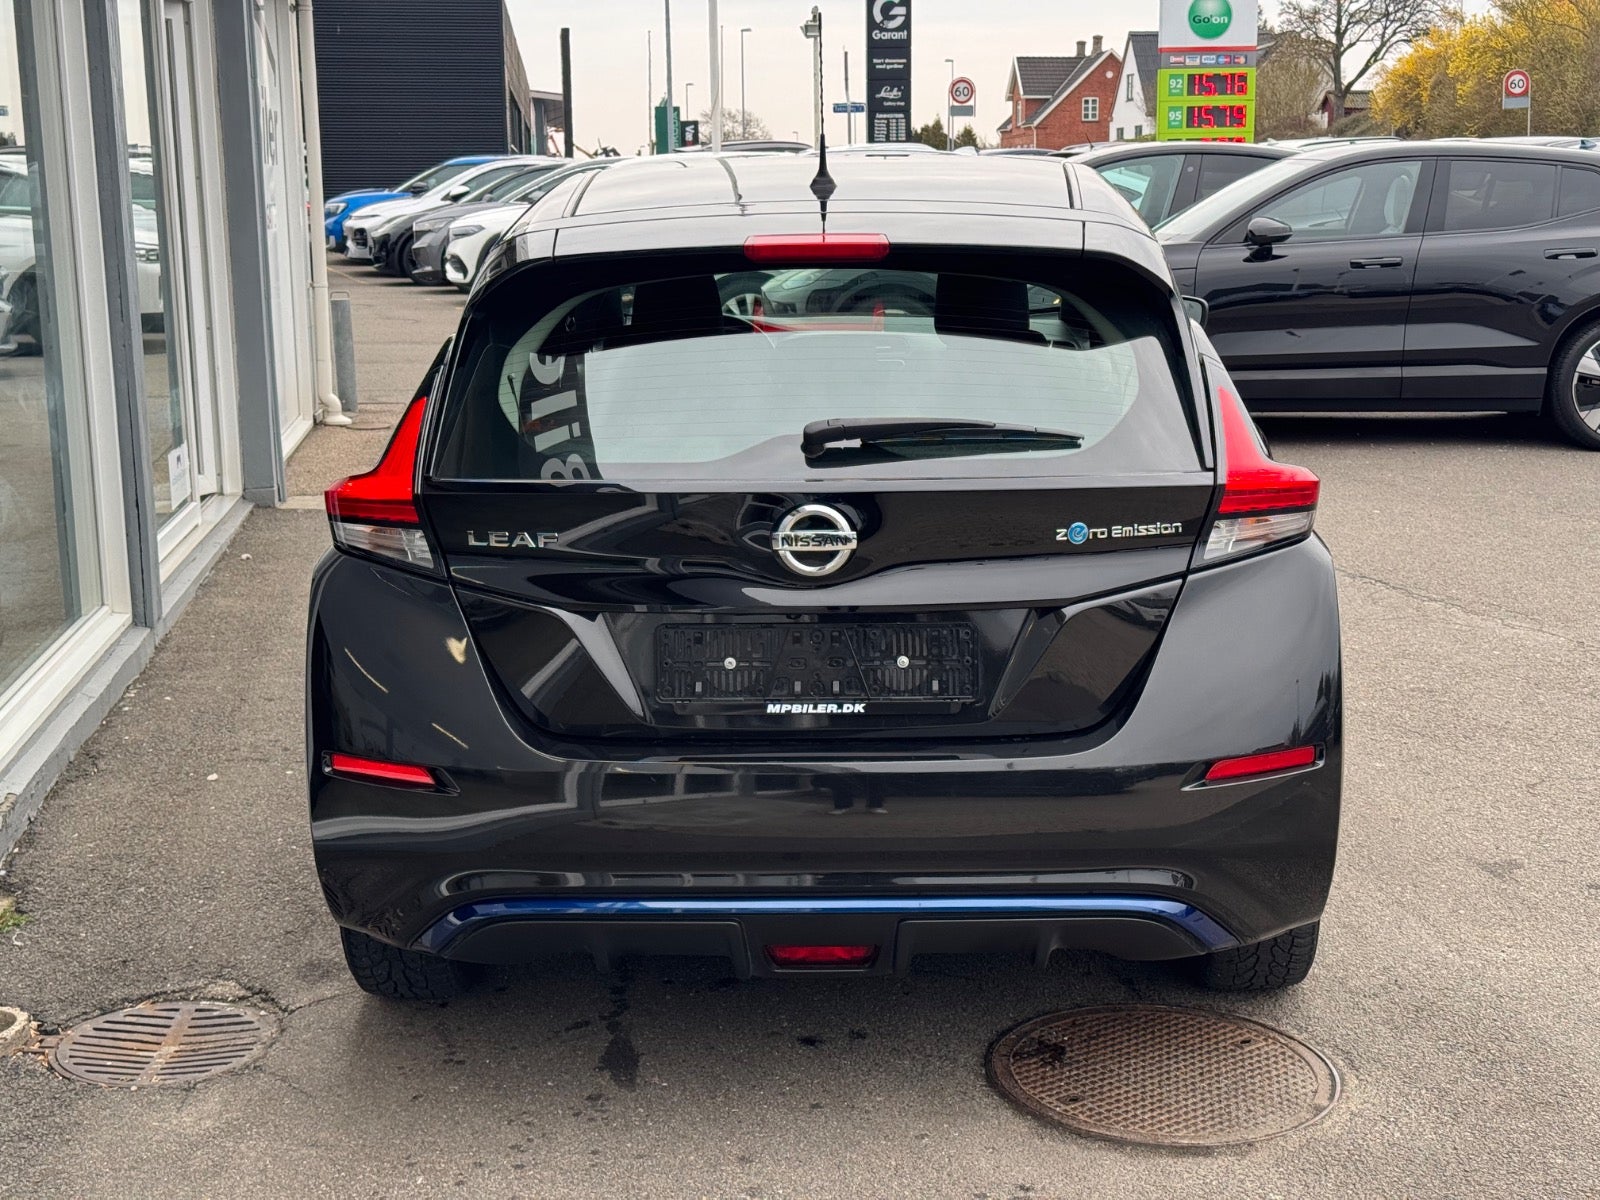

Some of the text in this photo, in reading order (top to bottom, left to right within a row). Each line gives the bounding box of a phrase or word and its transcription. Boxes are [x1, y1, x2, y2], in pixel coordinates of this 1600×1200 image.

[872, 30, 908, 40] Garant
[1169, 78, 1183, 89] 92
[1510, 78, 1525, 89] 60
[955, 86, 970, 97] 60
[1168, 111, 1182, 121] 95
[261, 85, 278, 165] iler
[1111, 522, 1182, 538] Emission
[467, 530, 558, 548] LEAF
[781, 534, 849, 547] NISSAN
[766, 703, 867, 714] MPBILER.DK
